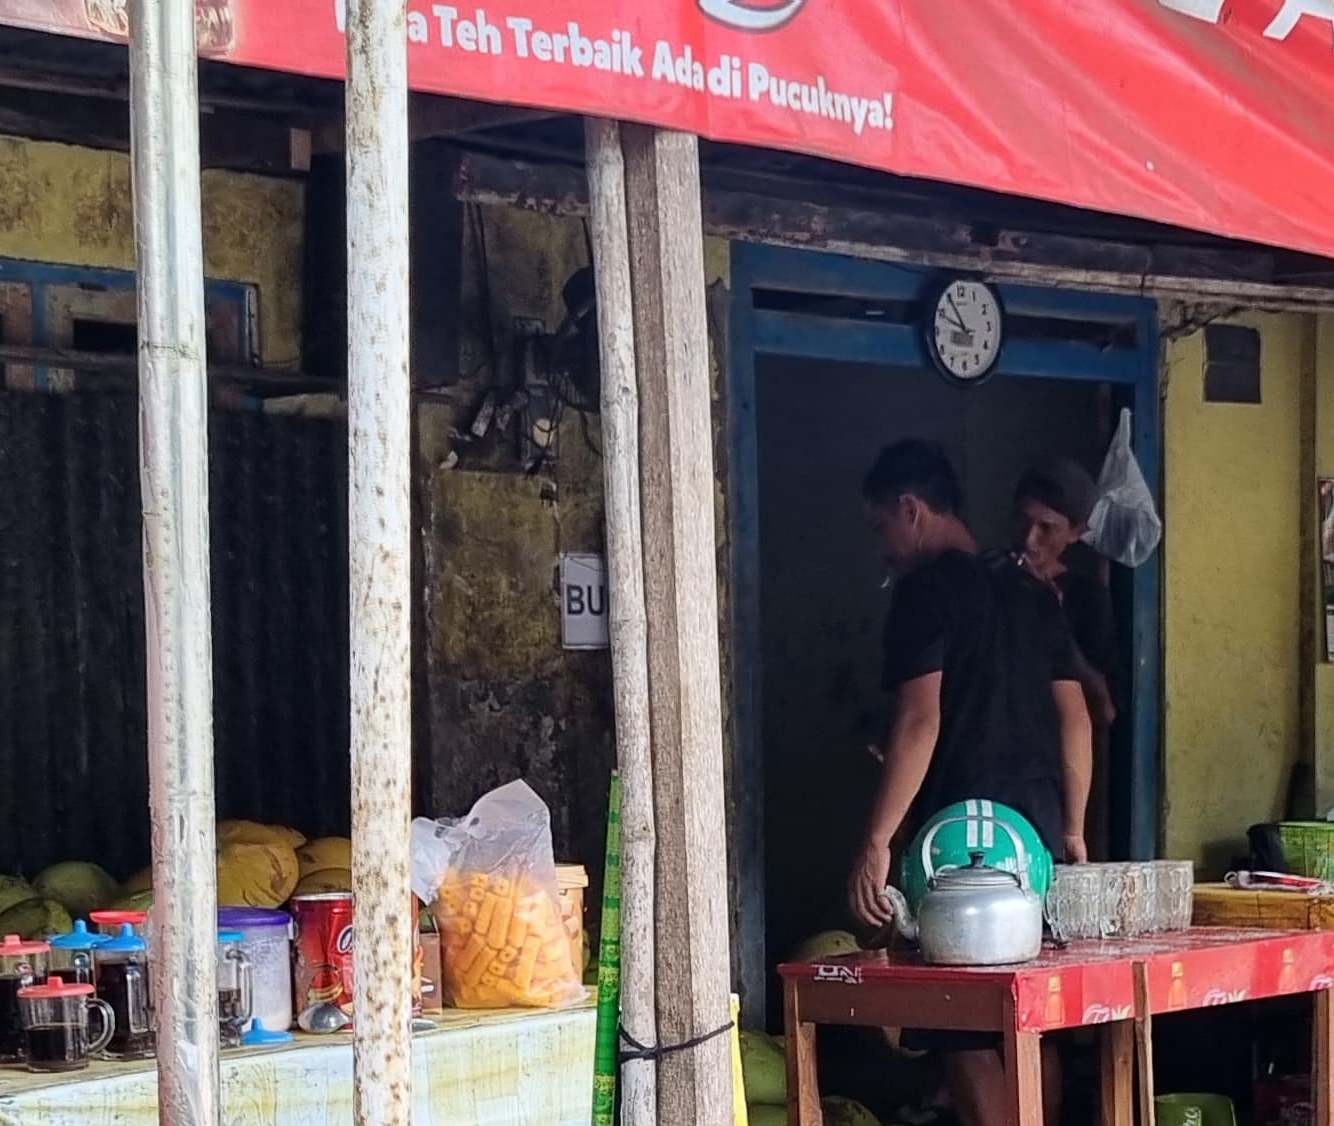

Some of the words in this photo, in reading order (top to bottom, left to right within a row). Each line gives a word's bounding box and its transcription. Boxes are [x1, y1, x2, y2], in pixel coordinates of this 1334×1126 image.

[432, 4, 502, 55] Teh
[506, 16, 644, 77] Terbaik
[652, 40, 704, 91] Ada
[707, 55, 742, 98] di
[748, 63, 894, 135] Pucuknya!
